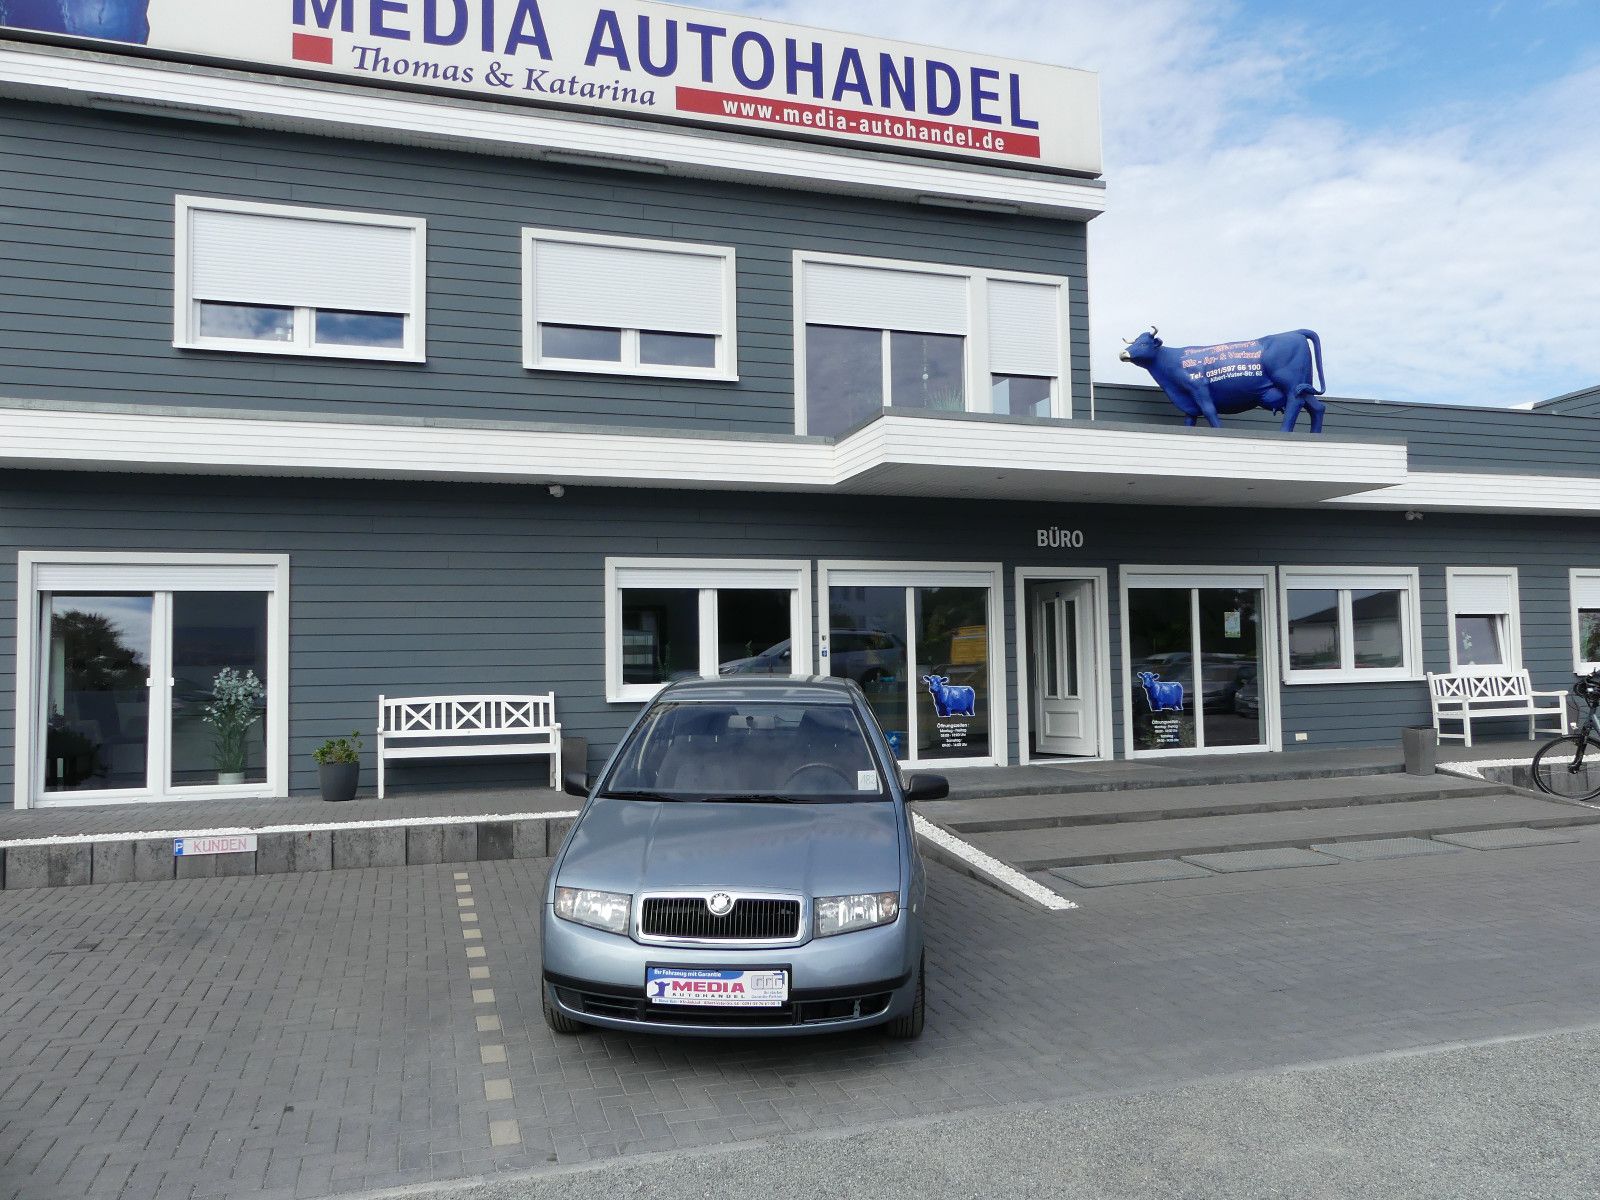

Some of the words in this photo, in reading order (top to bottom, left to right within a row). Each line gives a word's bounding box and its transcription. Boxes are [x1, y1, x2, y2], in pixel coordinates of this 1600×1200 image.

[351, 45, 474, 83] Thomas
[484, 61, 514, 88] &
[522, 68, 656, 106] Katarina
[584, 8, 1040, 130] AUTOHANDEL
[723, 100, 1005, 151] www.media-autohandel.de
[1190, 372, 1204, 380] Tel.
[1247, 363, 1261, 371] 100
[1037, 526, 1084, 548] BÜRO
[175, 842, 183, 852] P
[193, 838, 247, 852] KUNDEN
[662, 969, 687, 978] Fahrzeug
[672, 981, 745, 993] MEDIA
